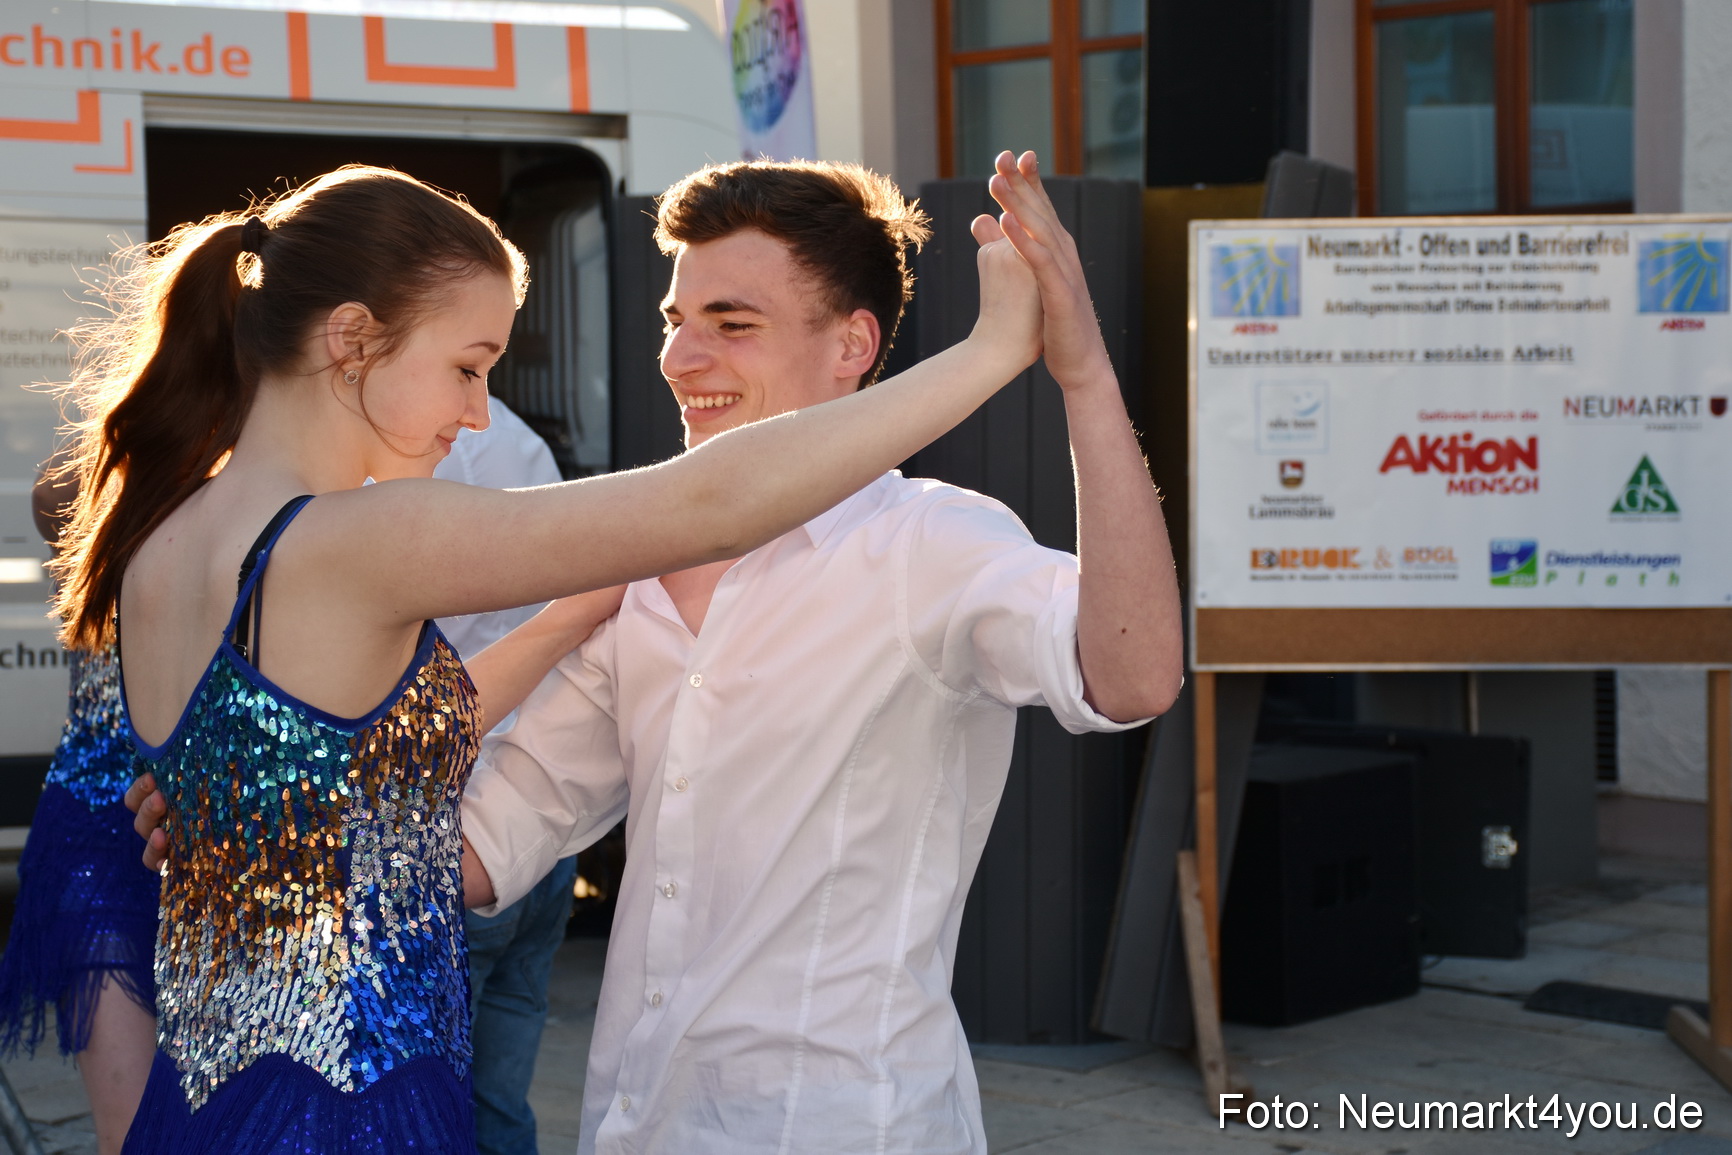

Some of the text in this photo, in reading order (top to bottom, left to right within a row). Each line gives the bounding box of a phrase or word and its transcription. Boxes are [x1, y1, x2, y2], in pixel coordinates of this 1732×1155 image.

[1307, 233, 1400, 258] Neumarkt
[1419, 233, 1470, 256] Offen
[1476, 233, 1511, 256] und
[1518, 231, 1629, 256] Barrierefrei
[1208, 345, 1574, 365] Unterstützer unserer sozialen Arbeit
[1418, 409, 1539, 421] Gefördert durch die
[1563, 395, 1702, 418] NEUMARKT
[1446, 476, 1539, 494] MENSCH
[1249, 504, 1335, 519] Lammsbräu
[1373, 546, 1393, 570] &
[1546, 552, 1681, 572] Dienstleistungen
